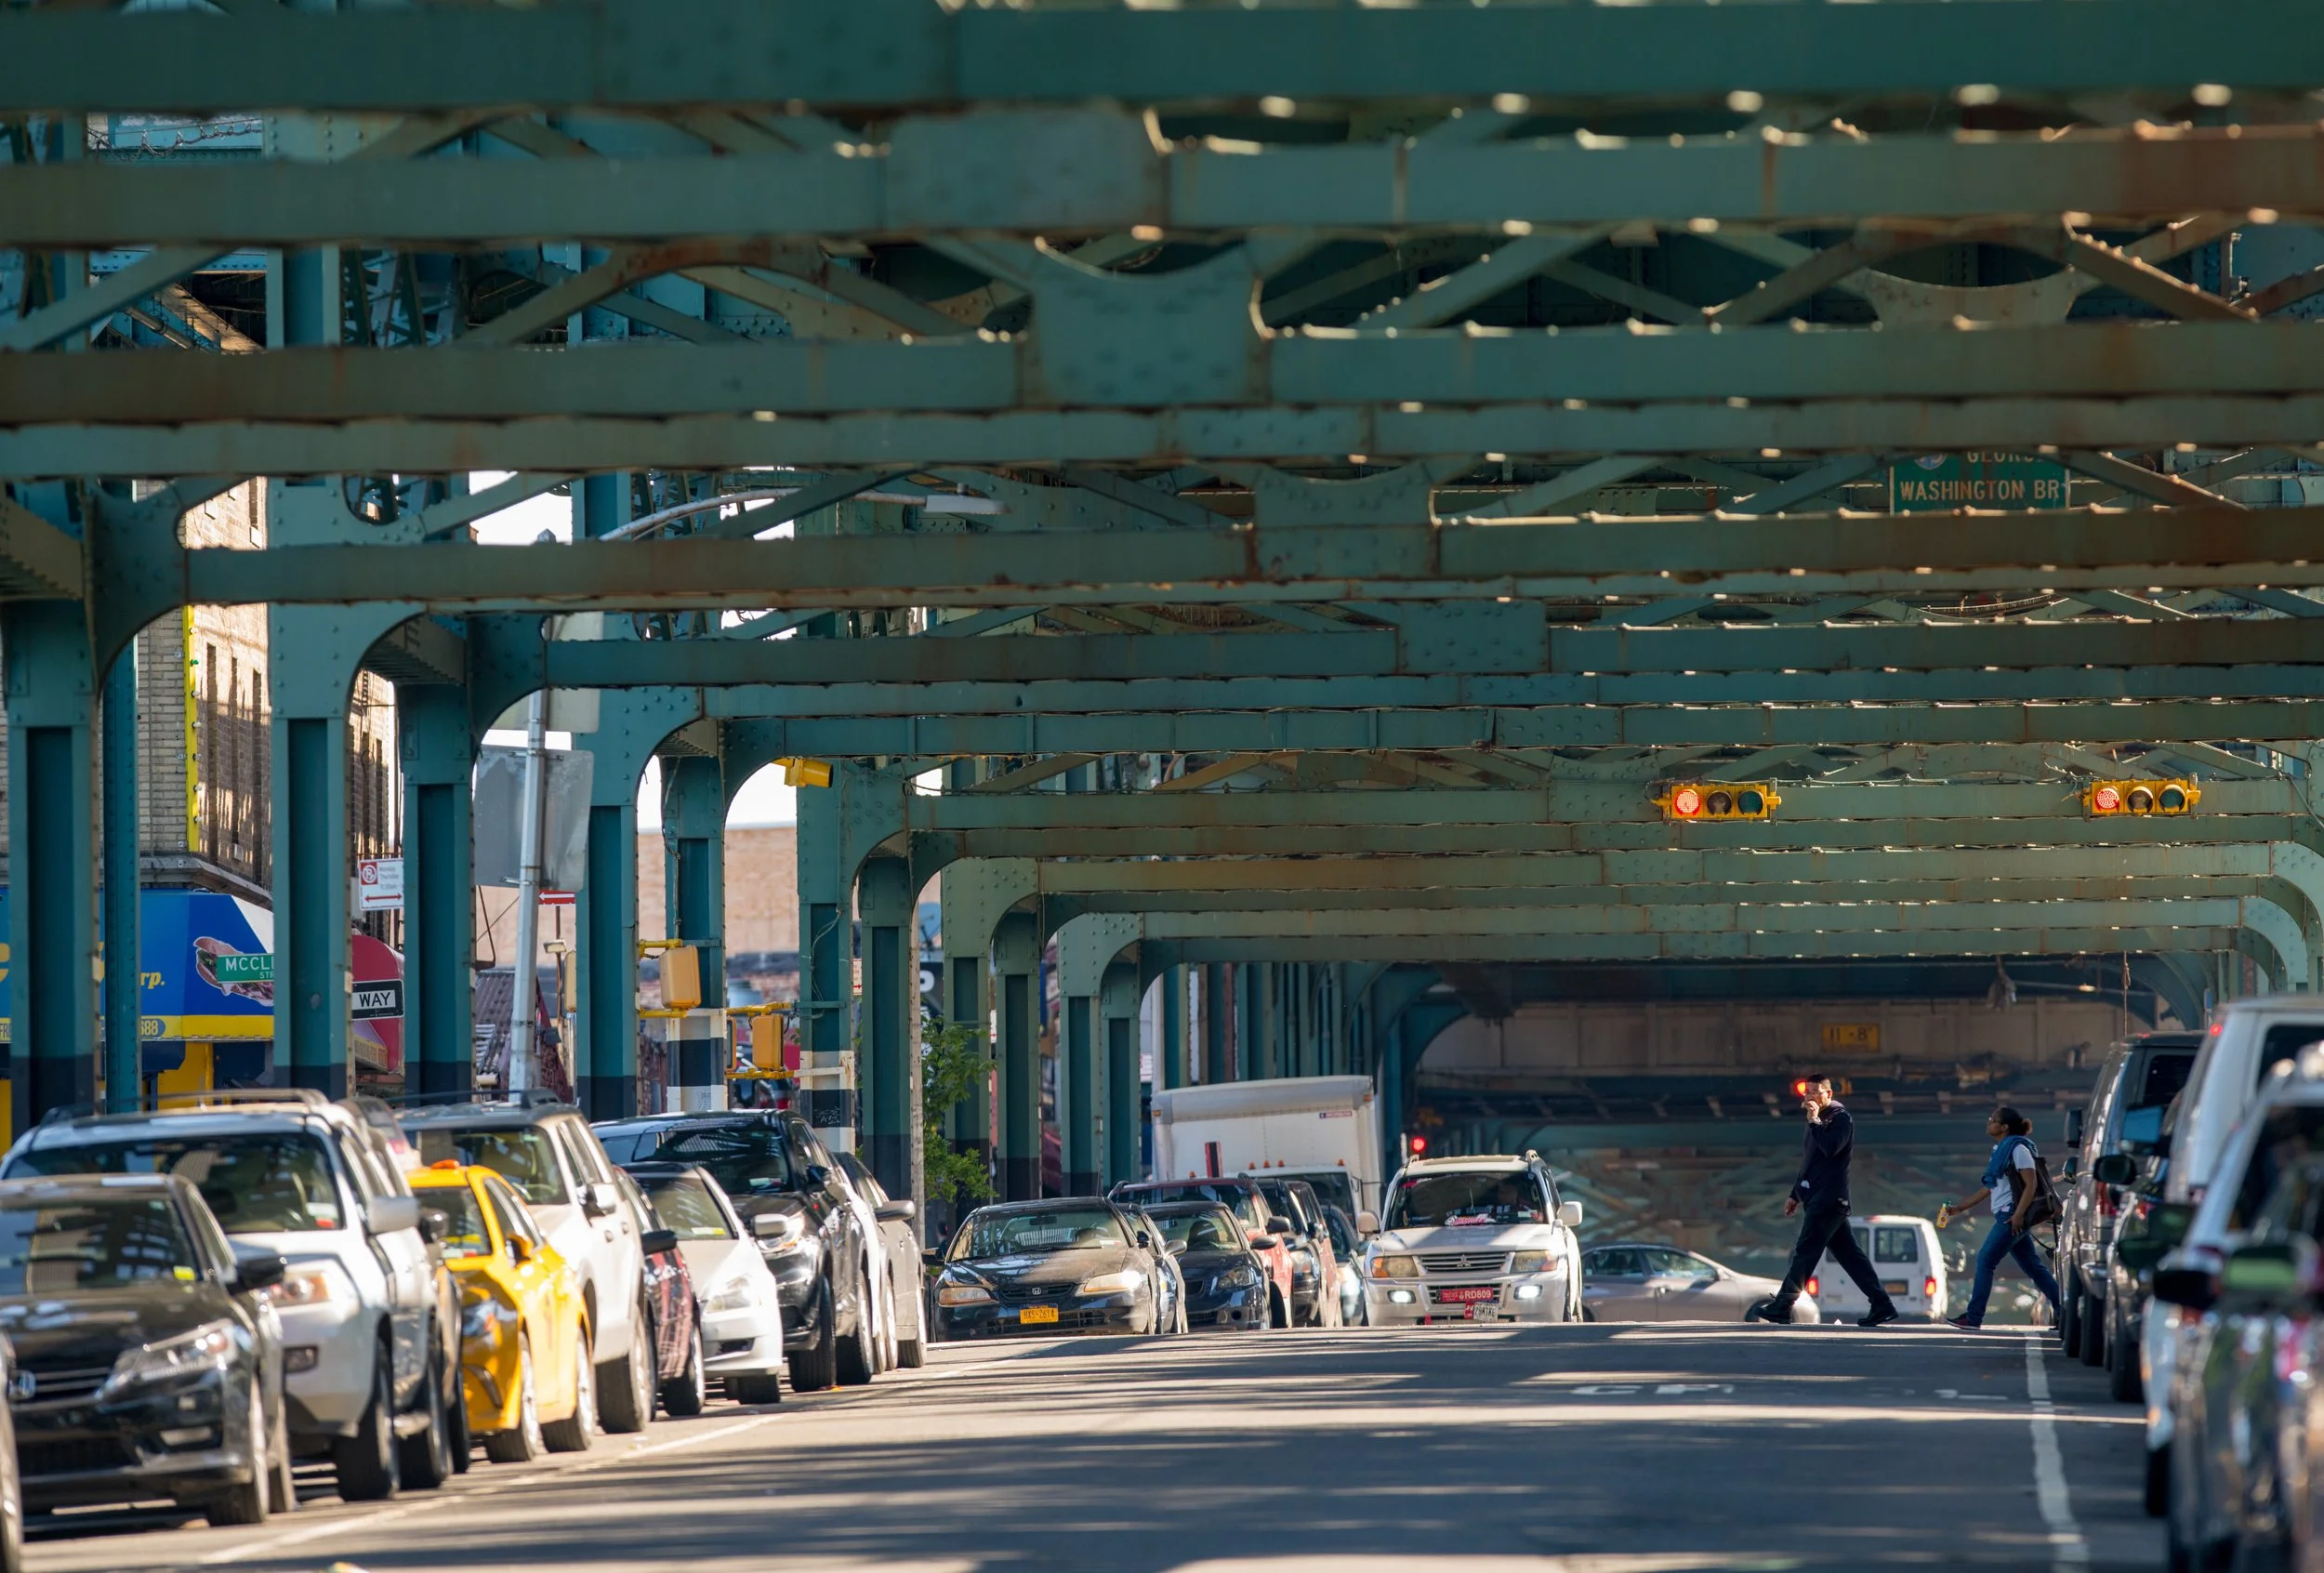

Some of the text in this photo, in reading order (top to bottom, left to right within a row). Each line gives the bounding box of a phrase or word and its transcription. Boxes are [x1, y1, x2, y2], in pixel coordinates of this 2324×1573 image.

[1967, 451, 2043, 463] GEO
[1899, 480, 2060, 501] WASHINGTON BR
[225, 957, 274, 972] MCCL
[359, 992, 391, 1007] WAY
[1464, 1289, 1491, 1300] RD809
